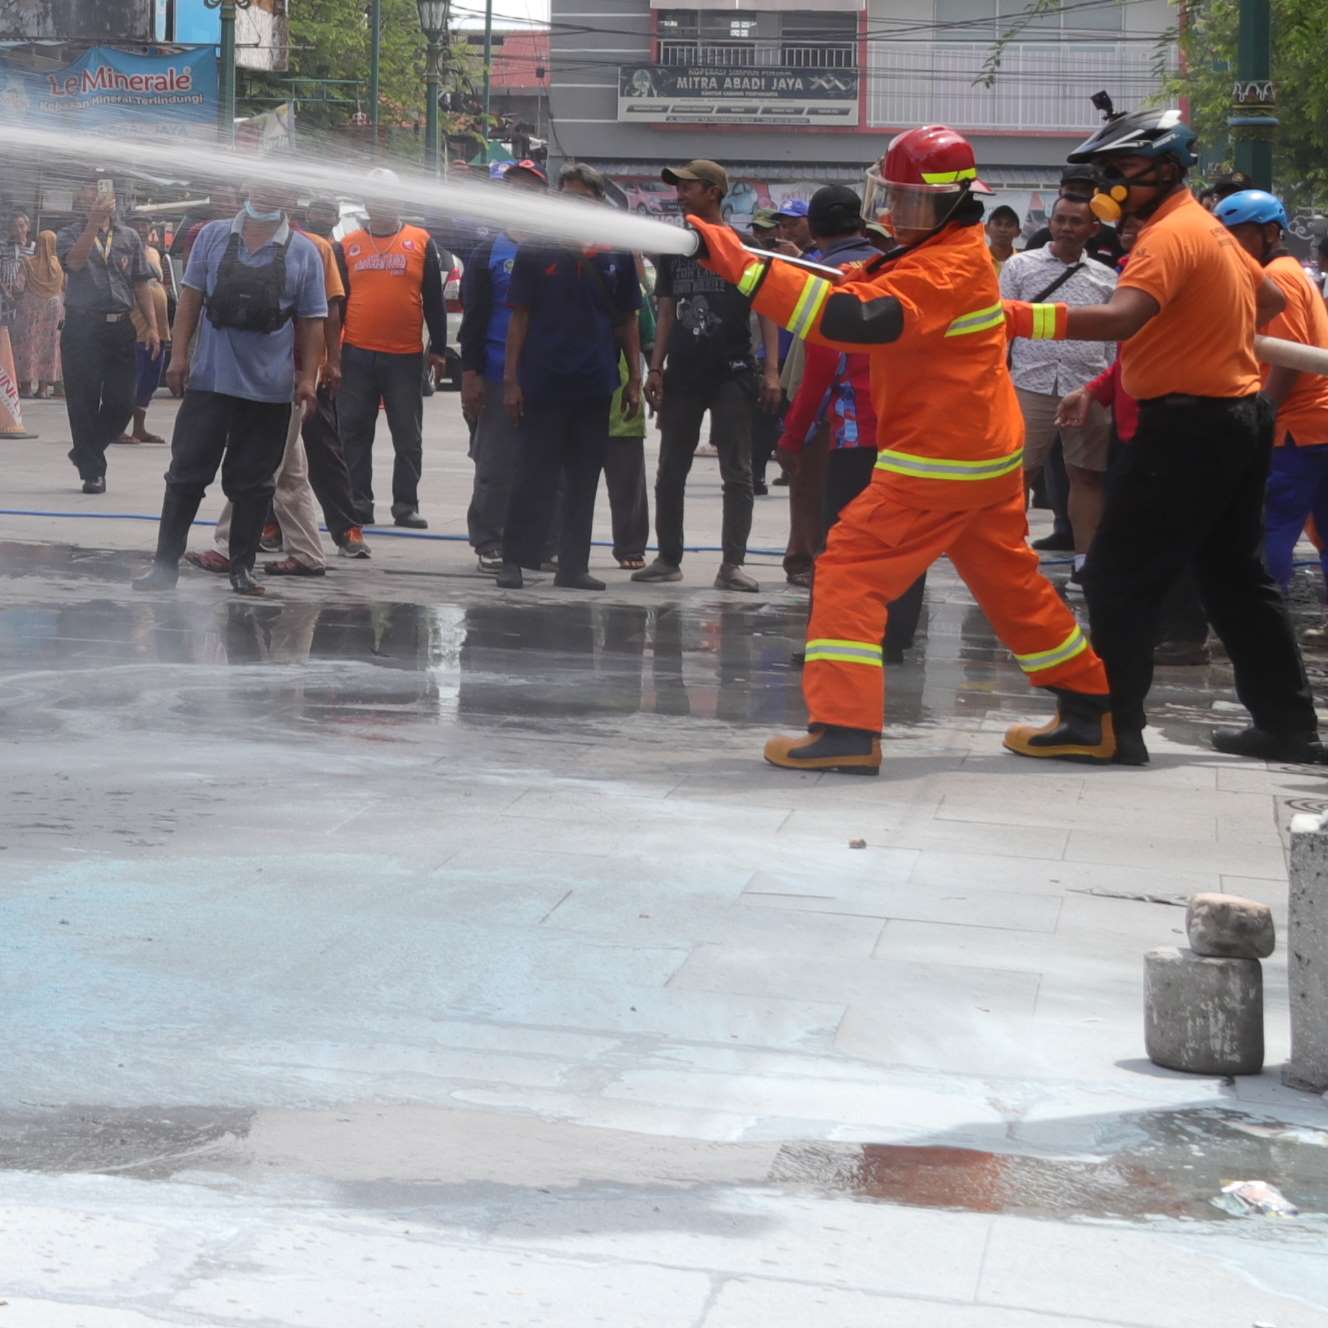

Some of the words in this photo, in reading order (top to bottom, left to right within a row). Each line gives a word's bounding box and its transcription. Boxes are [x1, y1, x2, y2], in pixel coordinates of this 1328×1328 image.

[48, 73, 80, 97] Le
[81, 66, 192, 94] Minerale
[676, 76, 718, 90] MITRA
[723, 76, 766, 90] ABADI
[771, 77, 804, 91] JAYA
